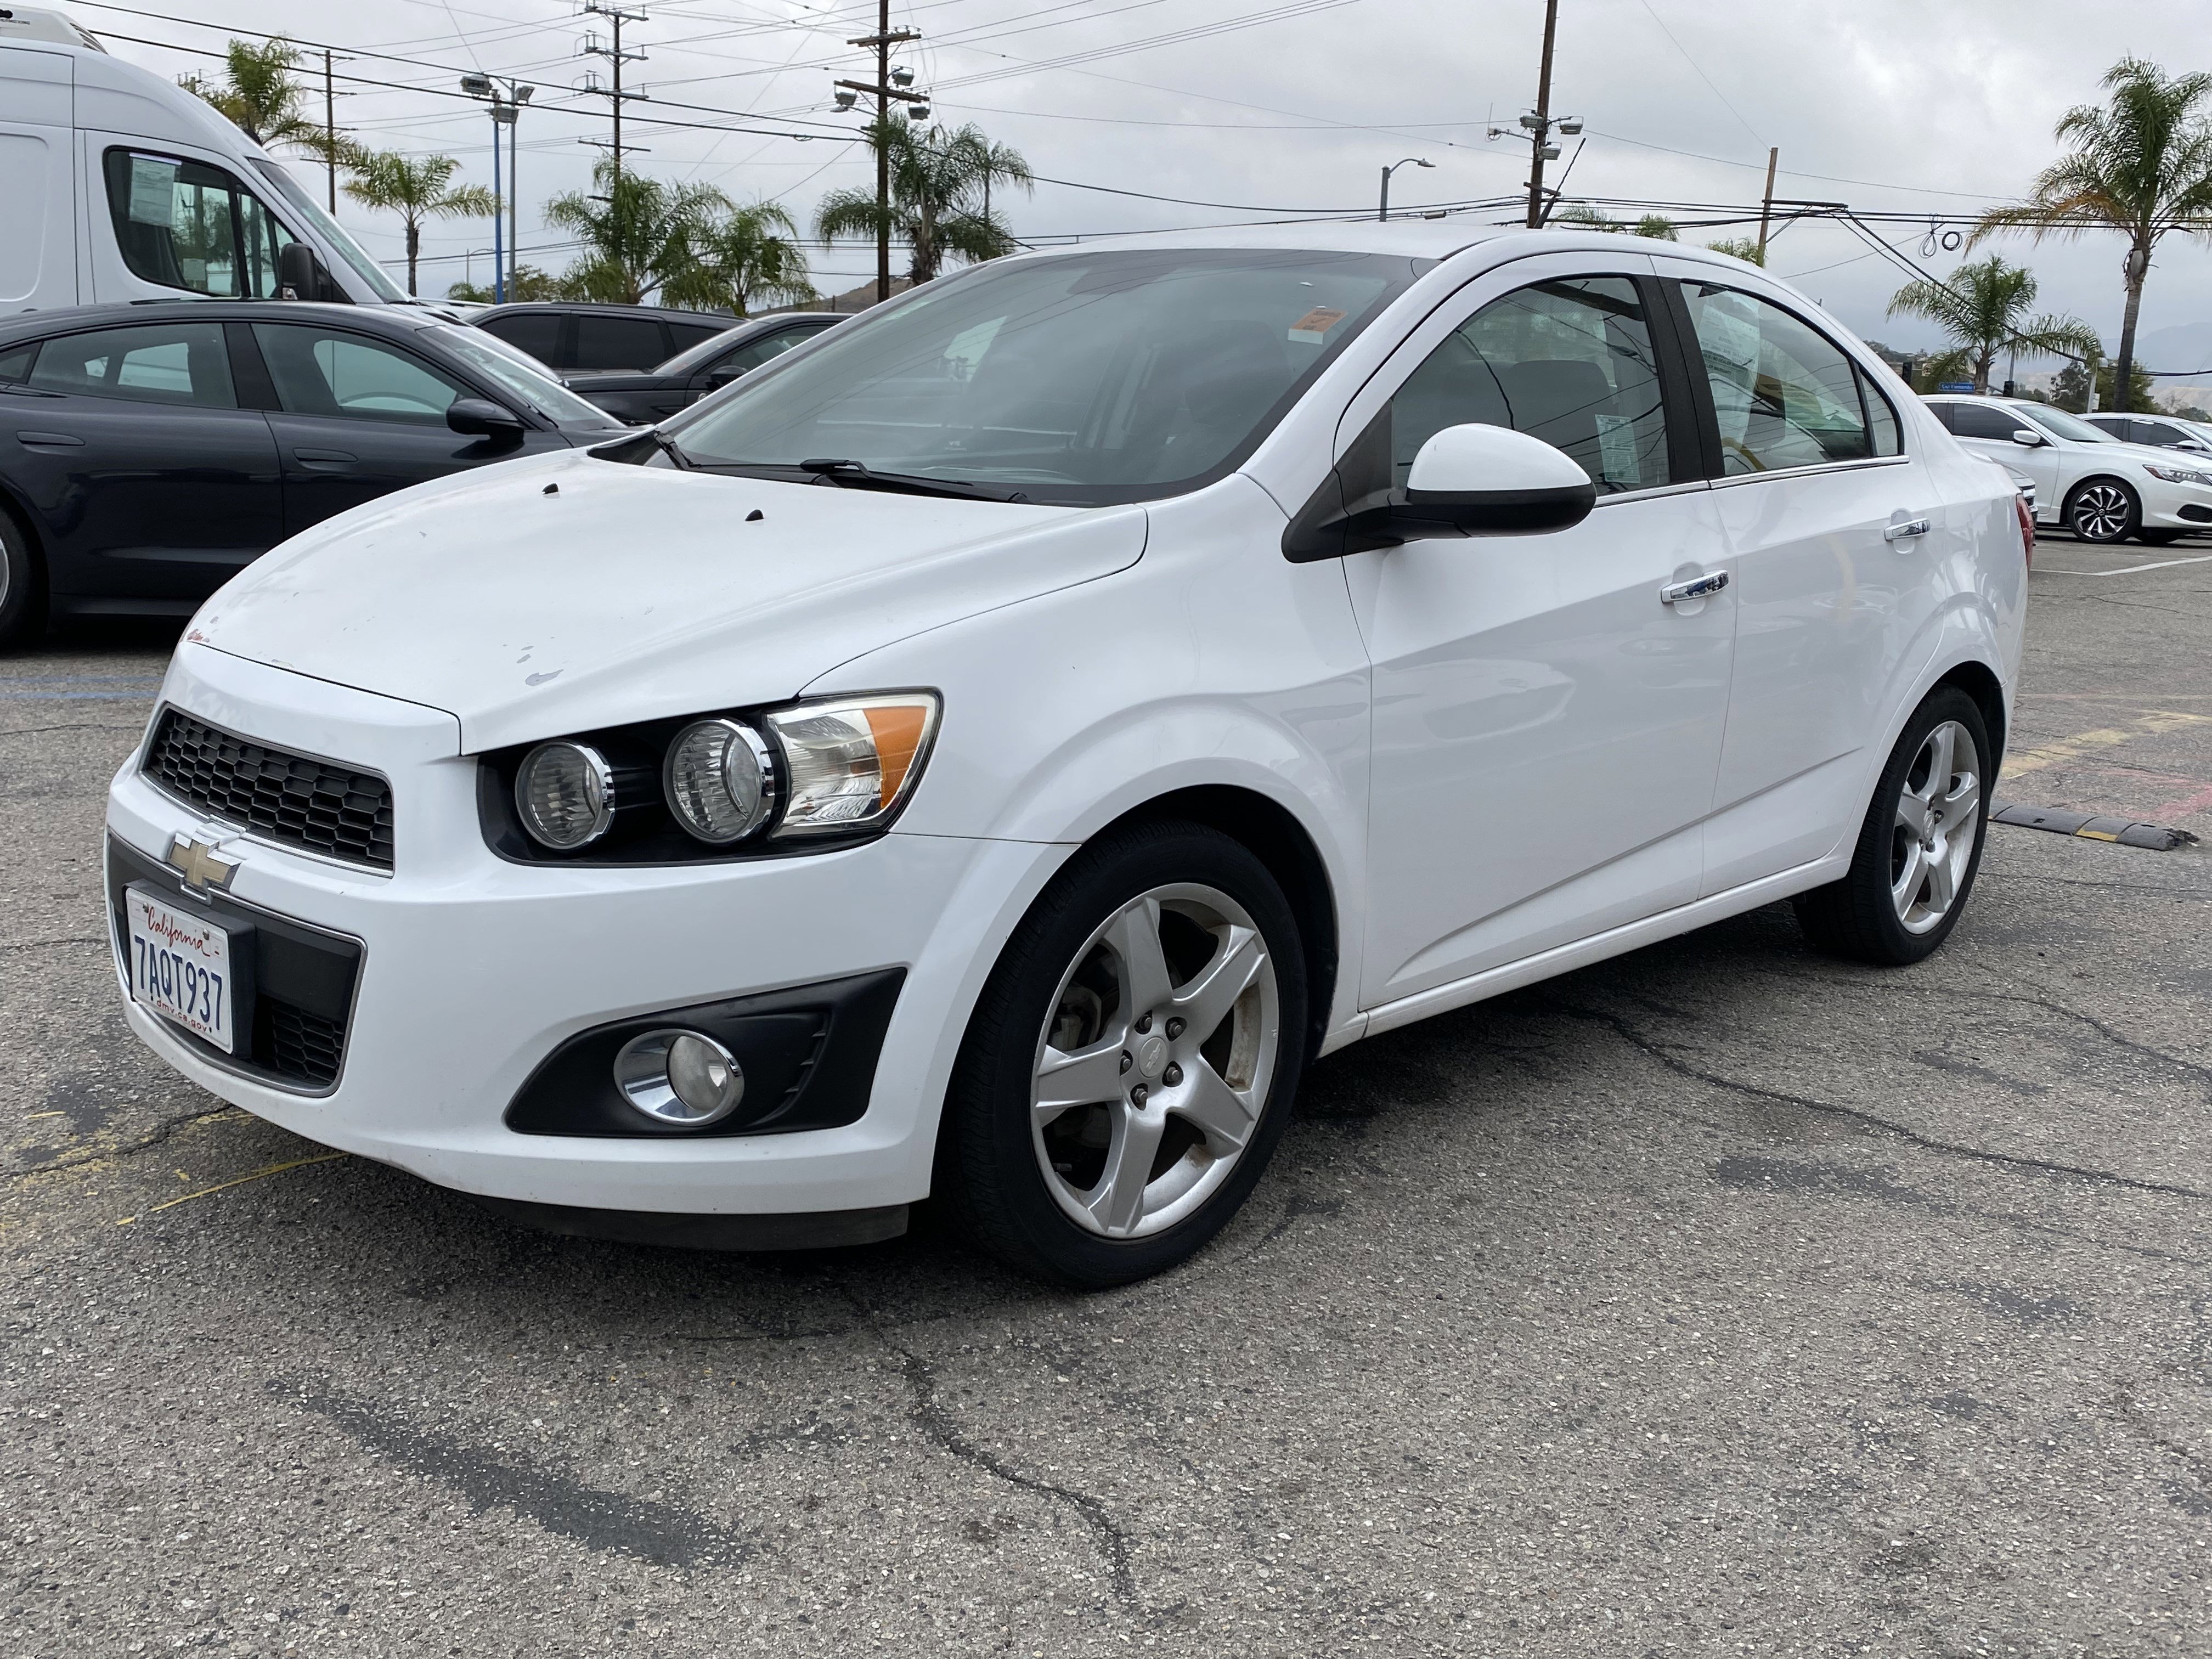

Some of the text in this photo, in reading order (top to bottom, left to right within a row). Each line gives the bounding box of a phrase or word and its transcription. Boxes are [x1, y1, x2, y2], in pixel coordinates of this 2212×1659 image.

[148, 906, 211, 957] California
[134, 934, 222, 1030] 7AQT937
[156, 1000, 207, 1032] dmv.ca.gov
